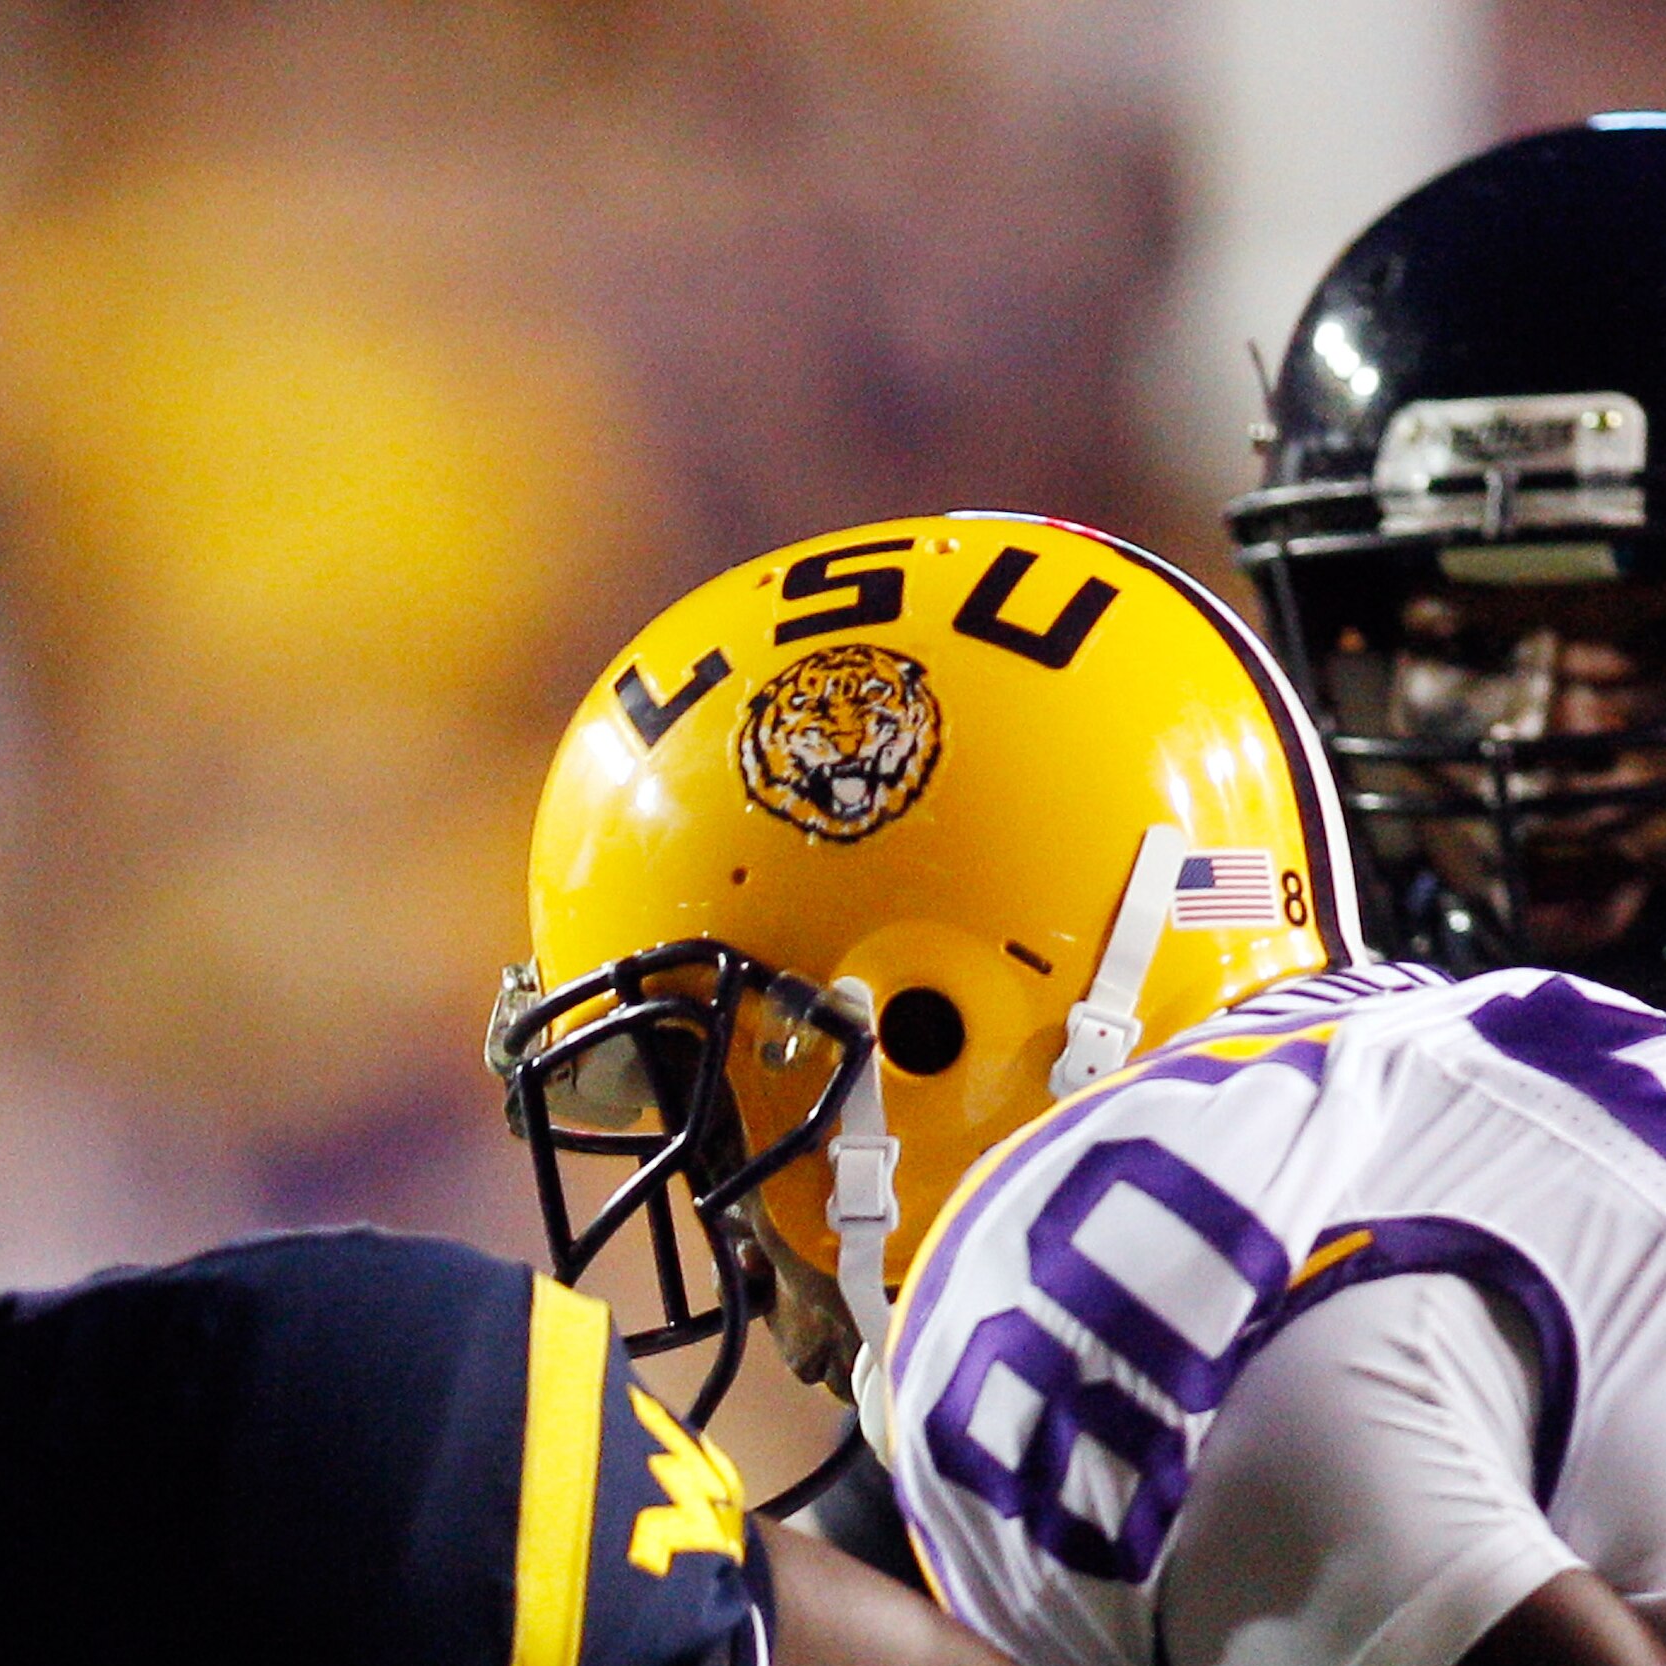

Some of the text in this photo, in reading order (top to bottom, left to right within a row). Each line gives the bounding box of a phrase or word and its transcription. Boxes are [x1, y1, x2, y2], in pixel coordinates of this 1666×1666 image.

[614, 537, 1120, 748] LSU
[1281, 870, 1308, 928] 8
[925, 1137, 1291, 1586] 80
